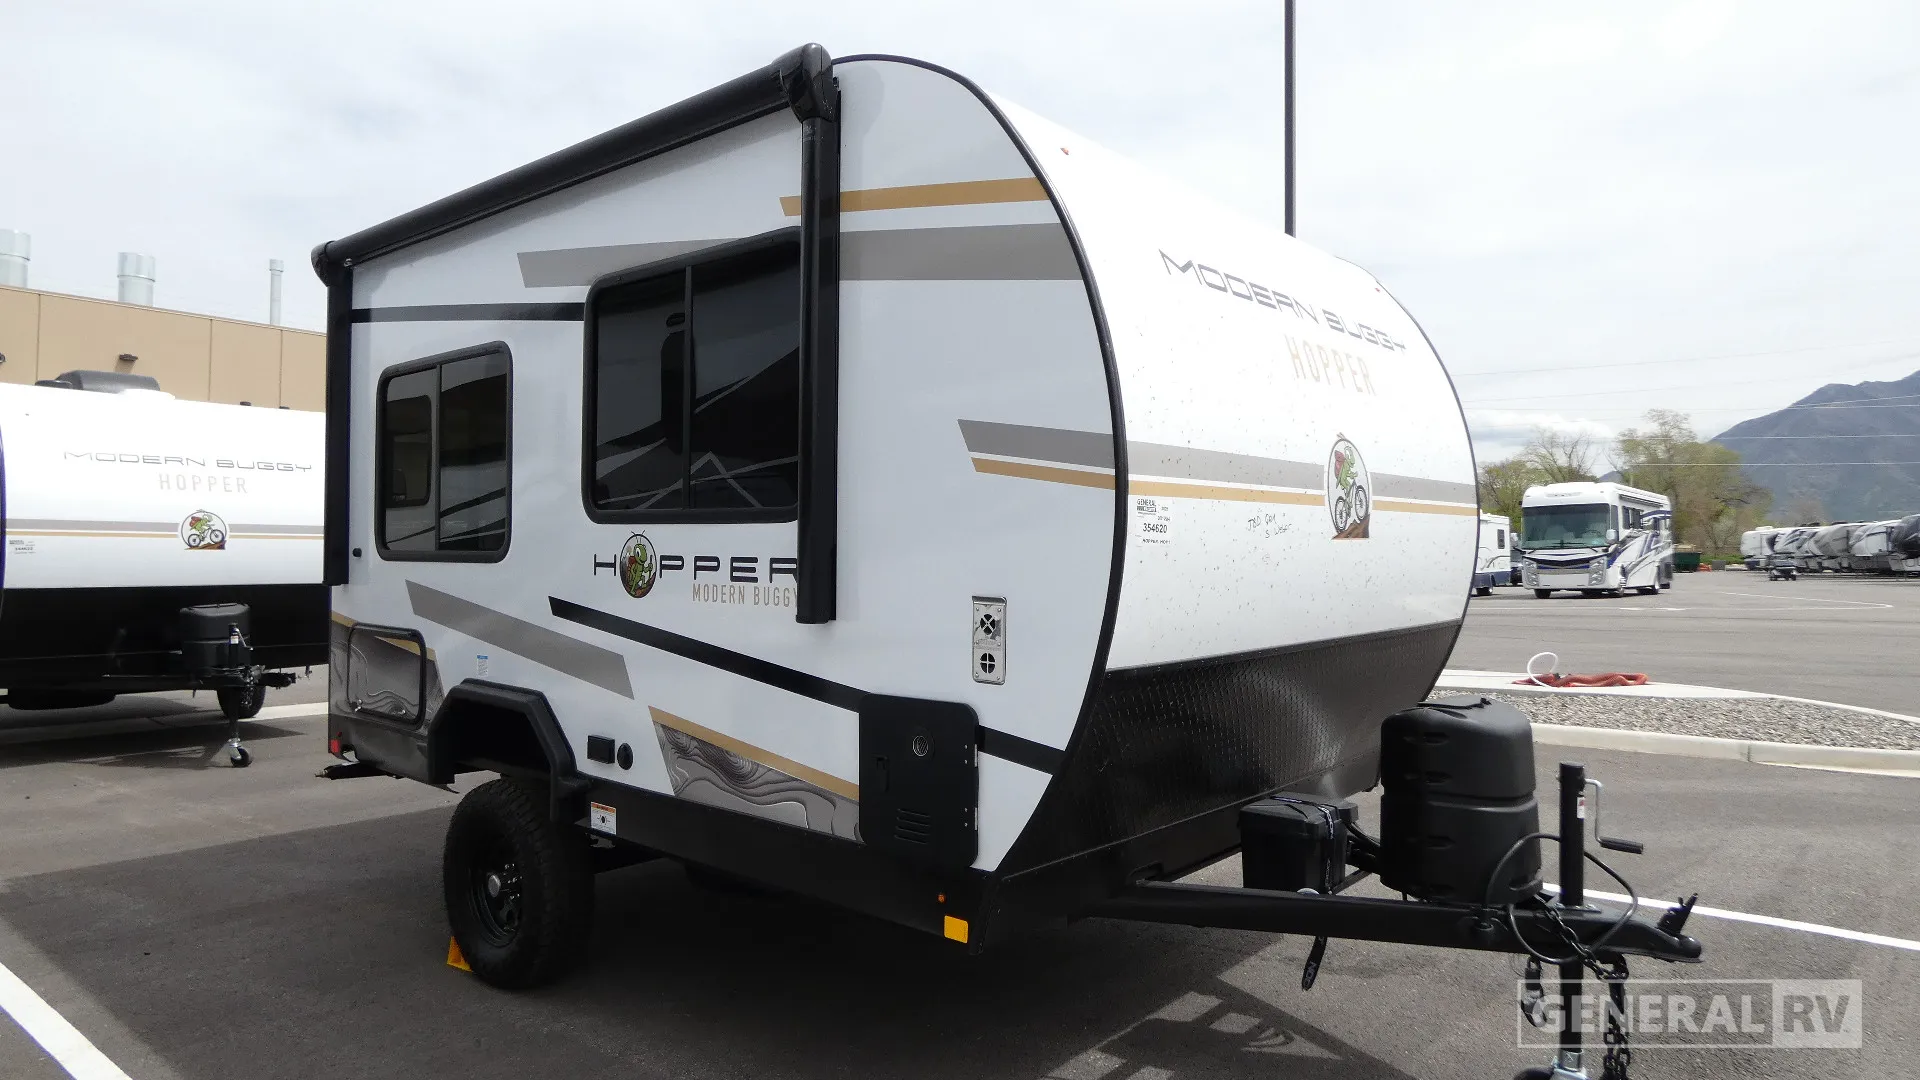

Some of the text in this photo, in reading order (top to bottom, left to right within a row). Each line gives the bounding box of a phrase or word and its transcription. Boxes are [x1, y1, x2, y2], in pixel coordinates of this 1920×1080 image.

[1158, 248, 1407, 355] MODERN BUGGY
[1284, 334, 1378, 397] HOPPER
[64, 452, 312, 472] MODERN BUGGY
[158, 474, 248, 494] HOPPER
[1142, 522, 1168, 534] 354620
[593, 540, 798, 595] HOPPER
[692, 583, 746, 605] MODERN
